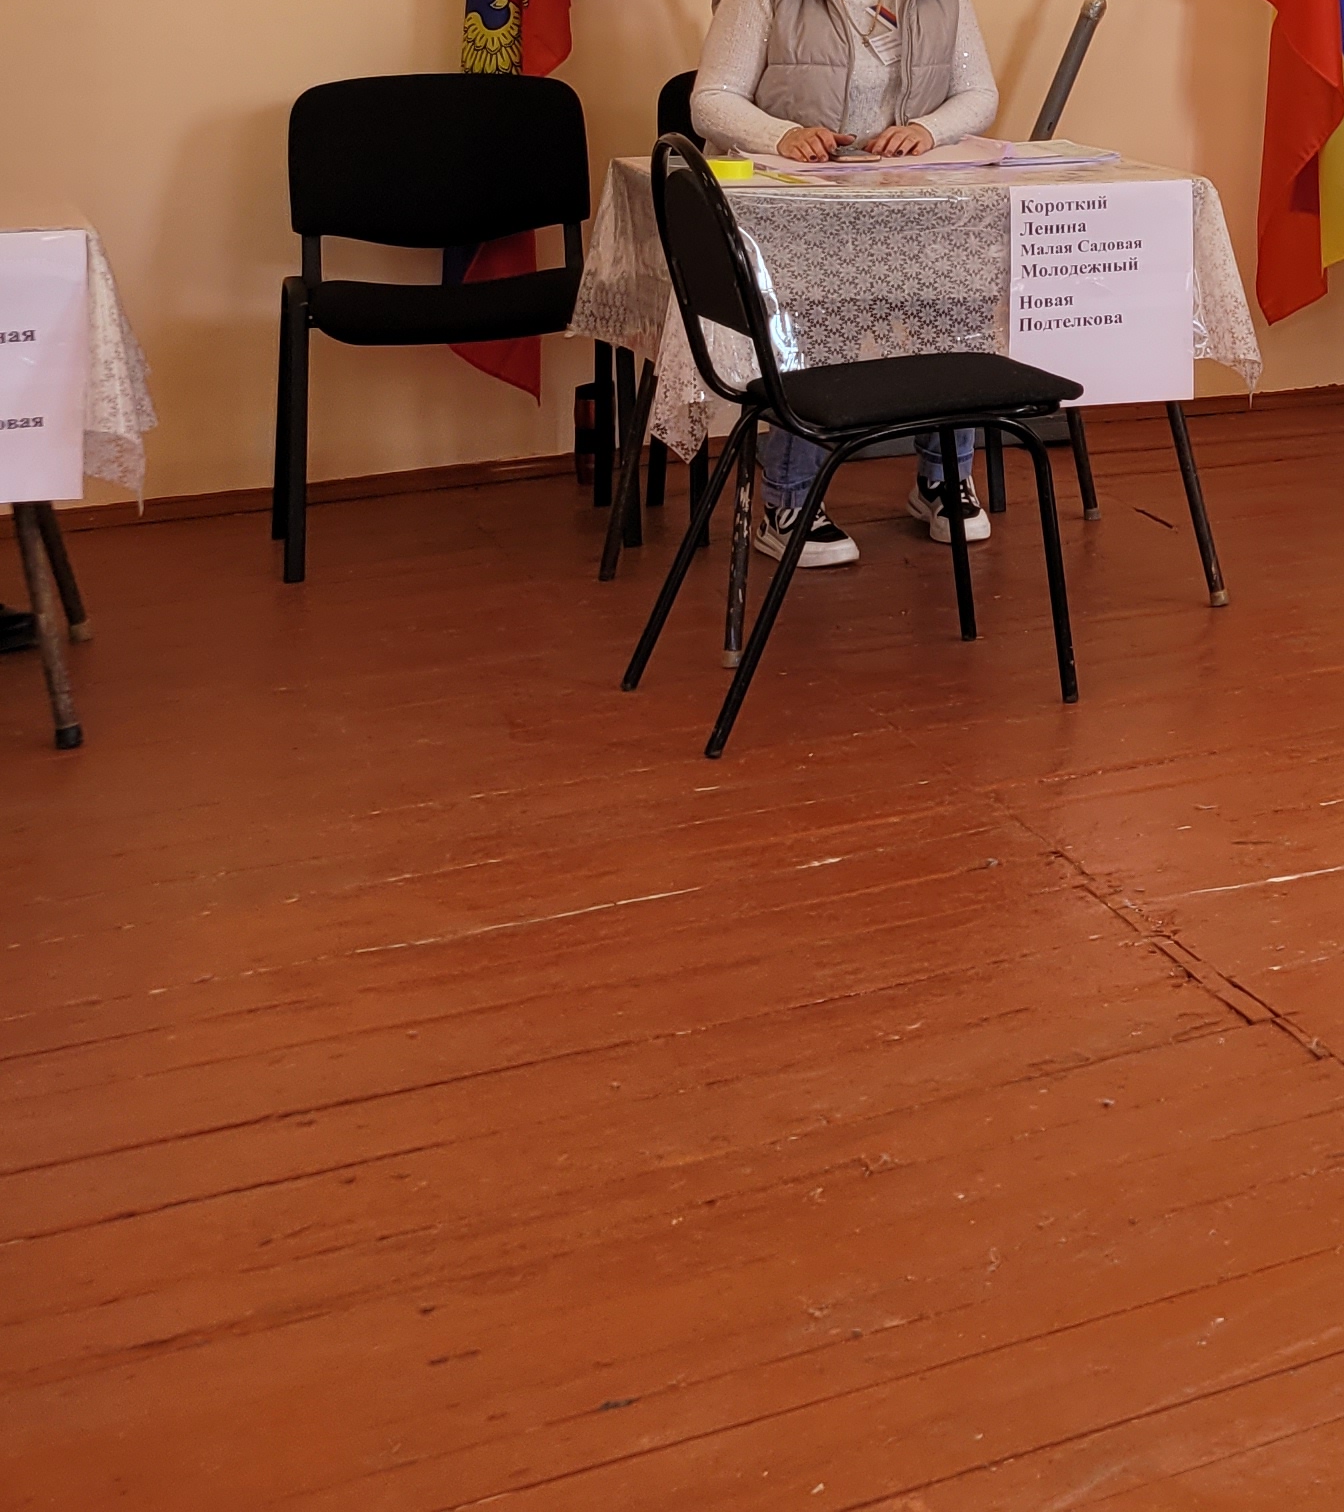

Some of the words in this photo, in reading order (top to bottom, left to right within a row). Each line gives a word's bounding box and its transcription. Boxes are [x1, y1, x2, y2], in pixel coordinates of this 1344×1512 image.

[1020, 196, 1108, 216] Короткий
[1020, 221, 1087, 237] Ленина
[1020, 243, 1073, 257] Малая
[1077, 239, 1142, 254] Садовая
[1021, 257, 1138, 279] Молодежный
[1019, 294, 1074, 310] Новая
[1019, 313, 1123, 332] Подтелкова
